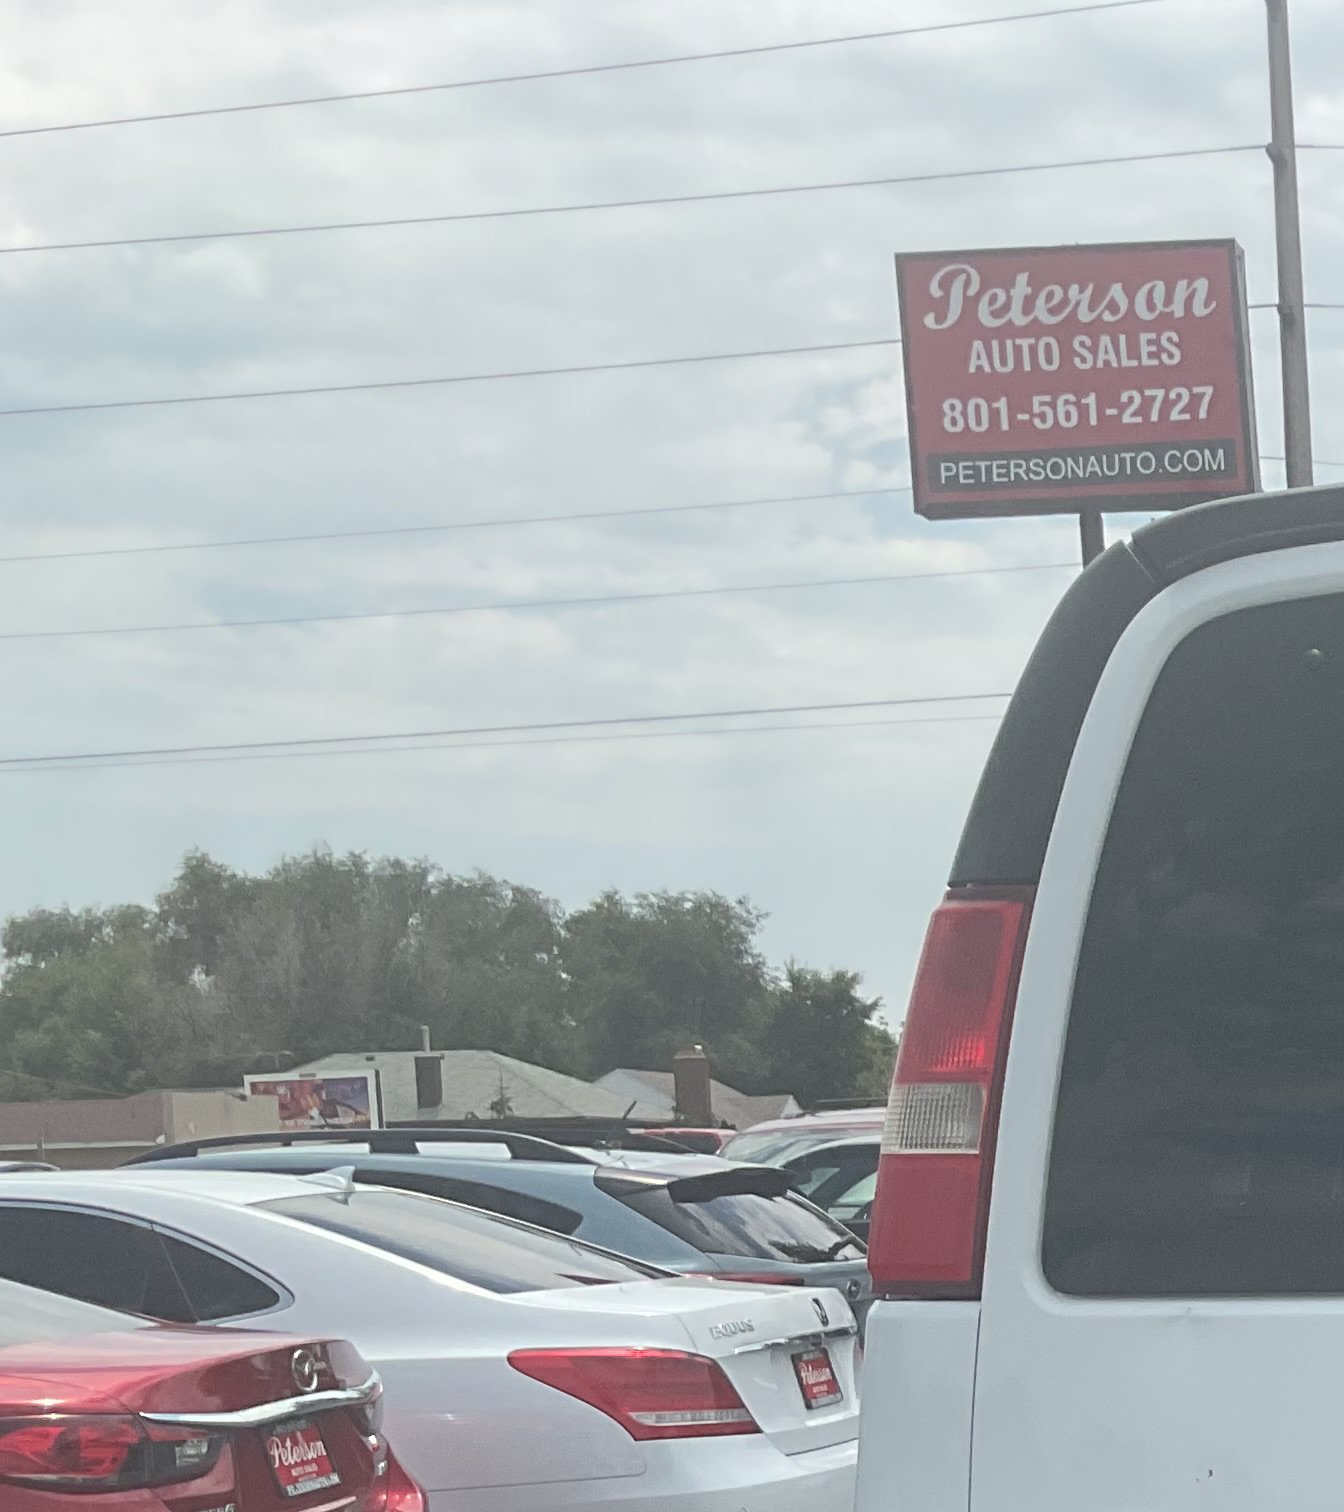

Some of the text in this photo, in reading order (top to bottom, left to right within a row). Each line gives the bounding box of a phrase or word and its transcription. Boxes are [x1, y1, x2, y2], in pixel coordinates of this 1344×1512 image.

[924, 264, 1217, 329] Peterson
[968, 331, 1182, 373] AUTO SALES
[942, 385, 1215, 433] 801-561-2727
[940, 449, 1226, 484] PETERSONAUTO.COM
